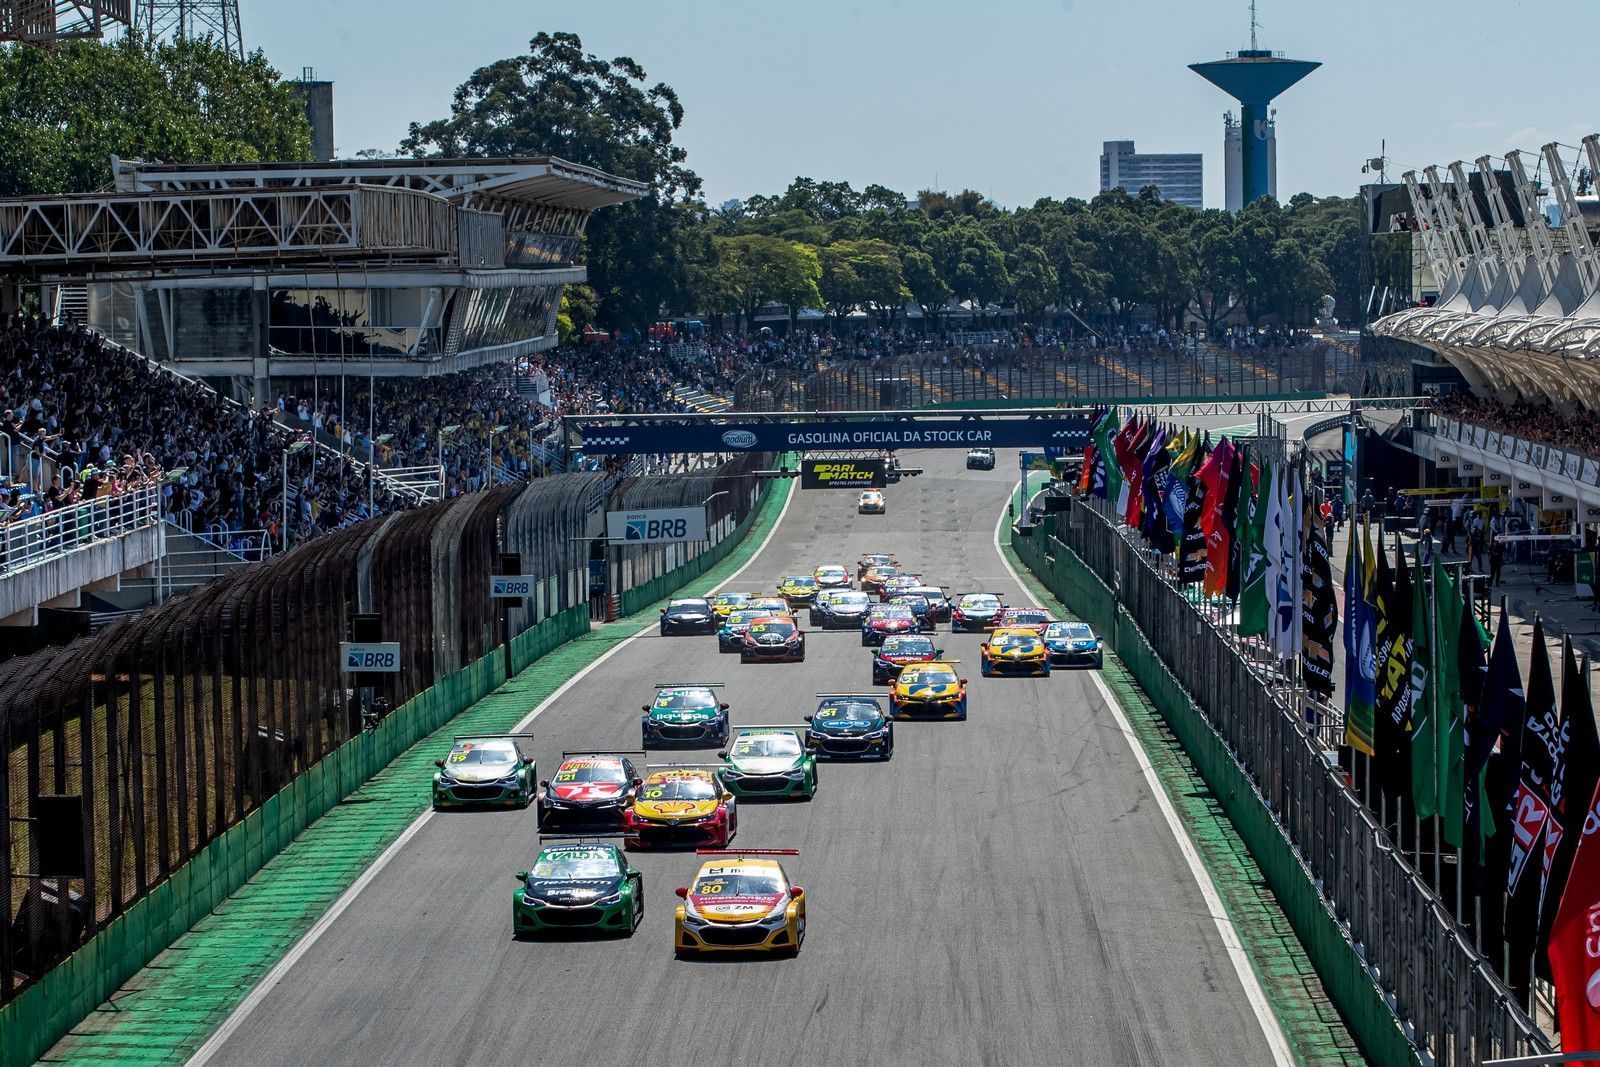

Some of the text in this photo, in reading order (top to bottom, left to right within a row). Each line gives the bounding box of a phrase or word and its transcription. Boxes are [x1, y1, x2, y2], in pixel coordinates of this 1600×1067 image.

[788, 430, 992, 444] GASOLINA OFICIAL DA STOCK CAR
[813, 464, 855, 472] PARI
[818, 471, 874, 480] MATCH
[647, 518, 687, 539] BRB
[506, 582, 529, 594] BRB
[364, 652, 395, 668] BRB
[452, 754, 467, 763] 19
[558, 772, 576, 781] 121
[645, 790, 663, 799] 10
[701, 885, 722, 894] 80
